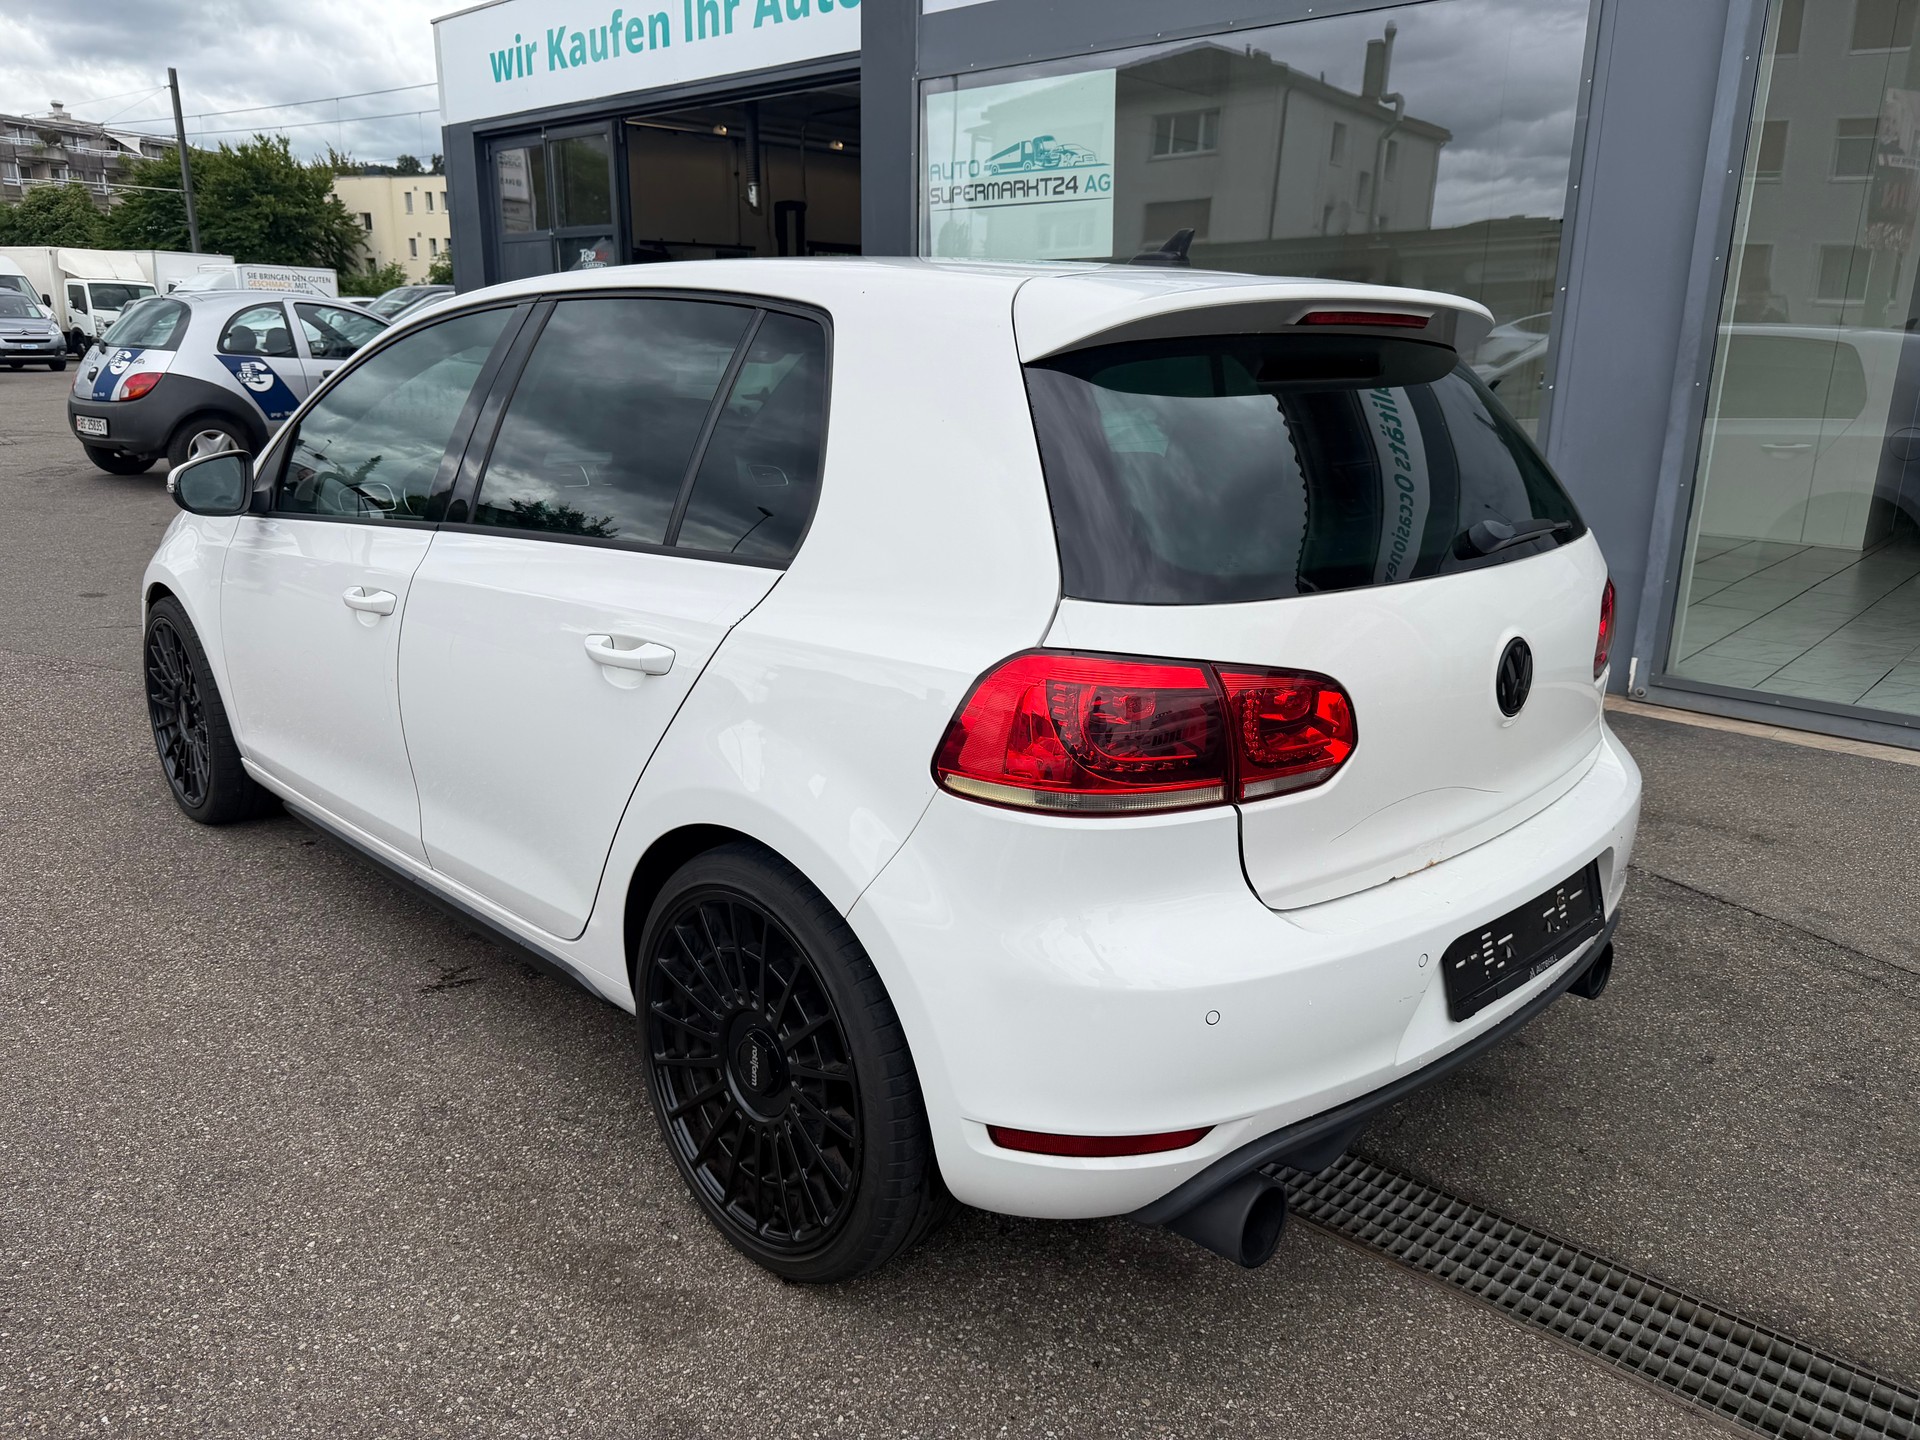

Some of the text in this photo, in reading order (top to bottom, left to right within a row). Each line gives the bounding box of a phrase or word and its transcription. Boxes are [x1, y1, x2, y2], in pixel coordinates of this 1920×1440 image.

[489, 0, 861, 83] wir Kaufen Ihr Au
[930, 159, 980, 182] AUTO
[930, 173, 1111, 205] SUPERMARKT24 AG
[247, 272, 331, 284] SIE BRINGEN DEN GUTEN
[248, 280, 293, 288] GESCHMACK
[750, 1045, 759, 1087] rotiform
